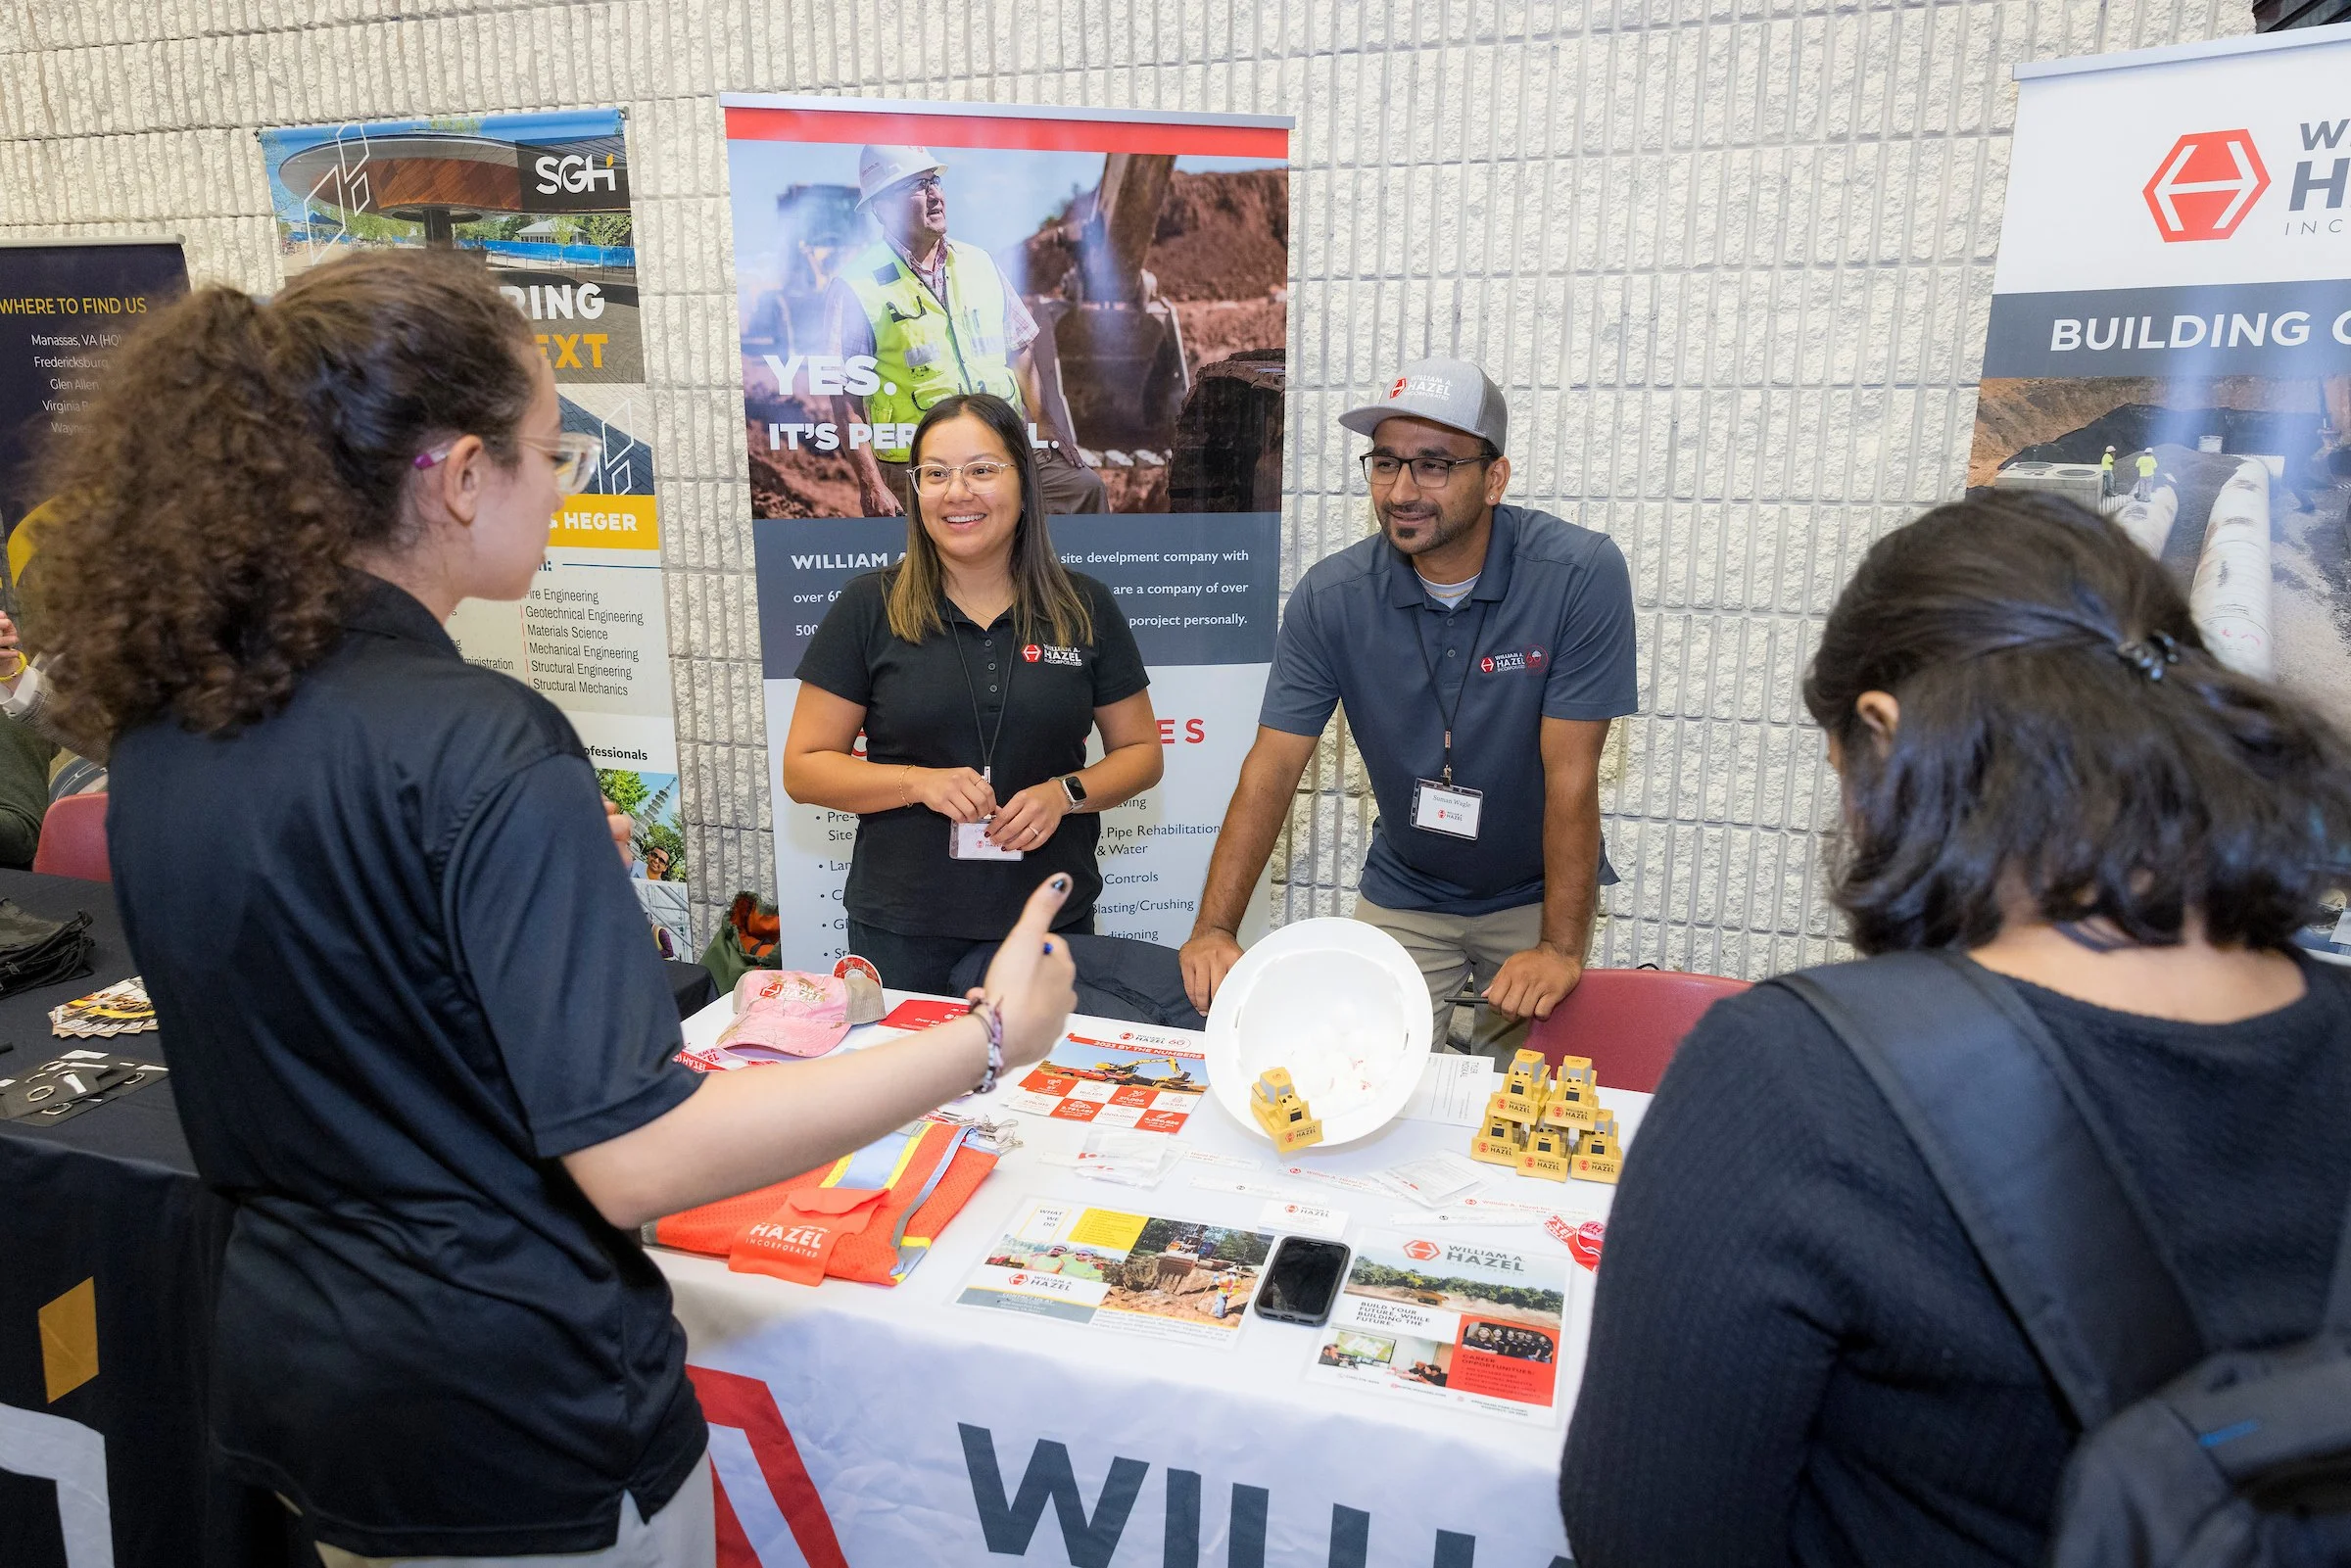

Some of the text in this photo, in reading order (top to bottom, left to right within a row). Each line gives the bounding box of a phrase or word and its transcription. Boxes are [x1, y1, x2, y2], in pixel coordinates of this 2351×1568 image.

[535, 153, 616, 195] SGH
[2288, 157, 2351, 212] H
[2284, 218, 2343, 236] INC
[0, 297, 148, 314] WHERE TO FIND US
[499, 282, 605, 320] RING
[2049, 310, 2311, 352] BUILDING
[30, 334, 81, 348] Manassas,
[81, 334, 98, 346] VA
[762, 354, 898, 397] YES.
[50, 378, 72, 391] Glen
[1407, 380, 1451, 397] HAZEL
[42, 400, 80, 414] Virginia
[563, 511, 639, 532] HEGER
[790, 551, 889, 570] WILLIAM
[1060, 552, 1083, 564] site
[1086, 551, 1160, 566] develpment
[1163, 551, 1220, 565] company
[1223, 549, 1249, 562] with
[544, 588, 600, 605] Engineering
[792, 594, 824, 604] over
[1113, 586, 1133, 595] are
[1147, 584, 1204, 597] company
[1205, 582, 1220, 594] of
[1221, 583, 1249, 594] over
[525, 605, 645, 626] Geotechnical Engineering
[1128, 615, 1181, 630] poroject
[1183, 612, 1249, 629] personally.
[527, 624, 608, 640] Materials Science
[529, 641, 640, 663] Mechanical Engineering
[1043, 648, 1082, 663] HAZEL
[462, 656, 514, 671] ministration
[1496, 656, 1526, 668] HAZEL
[531, 660, 633, 681] Structural Engineering
[533, 678, 629, 696] Structural Mechanics
[585, 745, 648, 761] ofessionals
[1115, 798, 1147, 811] aving
[827, 811, 861, 824] Pre-
[828, 830, 853, 841] Site
[1107, 826, 1132, 840] Pipe
[1137, 823, 1222, 836] Rehabilitation
[1096, 842, 1148, 856] & Water
[829, 859, 853, 872] Lan
[1104, 871, 1159, 885] Controls
[1092, 898, 1195, 915] Blasting/Crushing
[1107, 930, 1160, 941] ditioning
[1135, 1035, 1166, 1045] HAZEL
[1154, 1049, 1203, 1060] NUMBERS
[1509, 1103, 1531, 1114] HAZEL
[1565, 1111, 1589, 1120] HAZEL
[1295, 1127, 1317, 1138] HAZEL
[1490, 1147, 1512, 1156] HAZEL
[1537, 1161, 1560, 1171] HAZEL
[1591, 1164, 1615, 1173] HAZEL
[1300, 1209, 1329, 1218] HAZEL
[748, 1223, 824, 1250] HAZEL
[745, 1237, 819, 1259] INCORPORATED
[1449, 1245, 1508, 1259] WILLIAM
[1446, 1252, 1525, 1272] HAZEL
[1031, 1279, 1071, 1292] HAZEL
[1361, 1301, 1418, 1314] BUILD YOUR
[1356, 1316, 1395, 1327] FUTURE.
[1357, 1311, 1403, 1323] BUILDING
[1402, 1313, 1430, 1322] WHILE
[1463, 1354, 1496, 1363] CAREER
